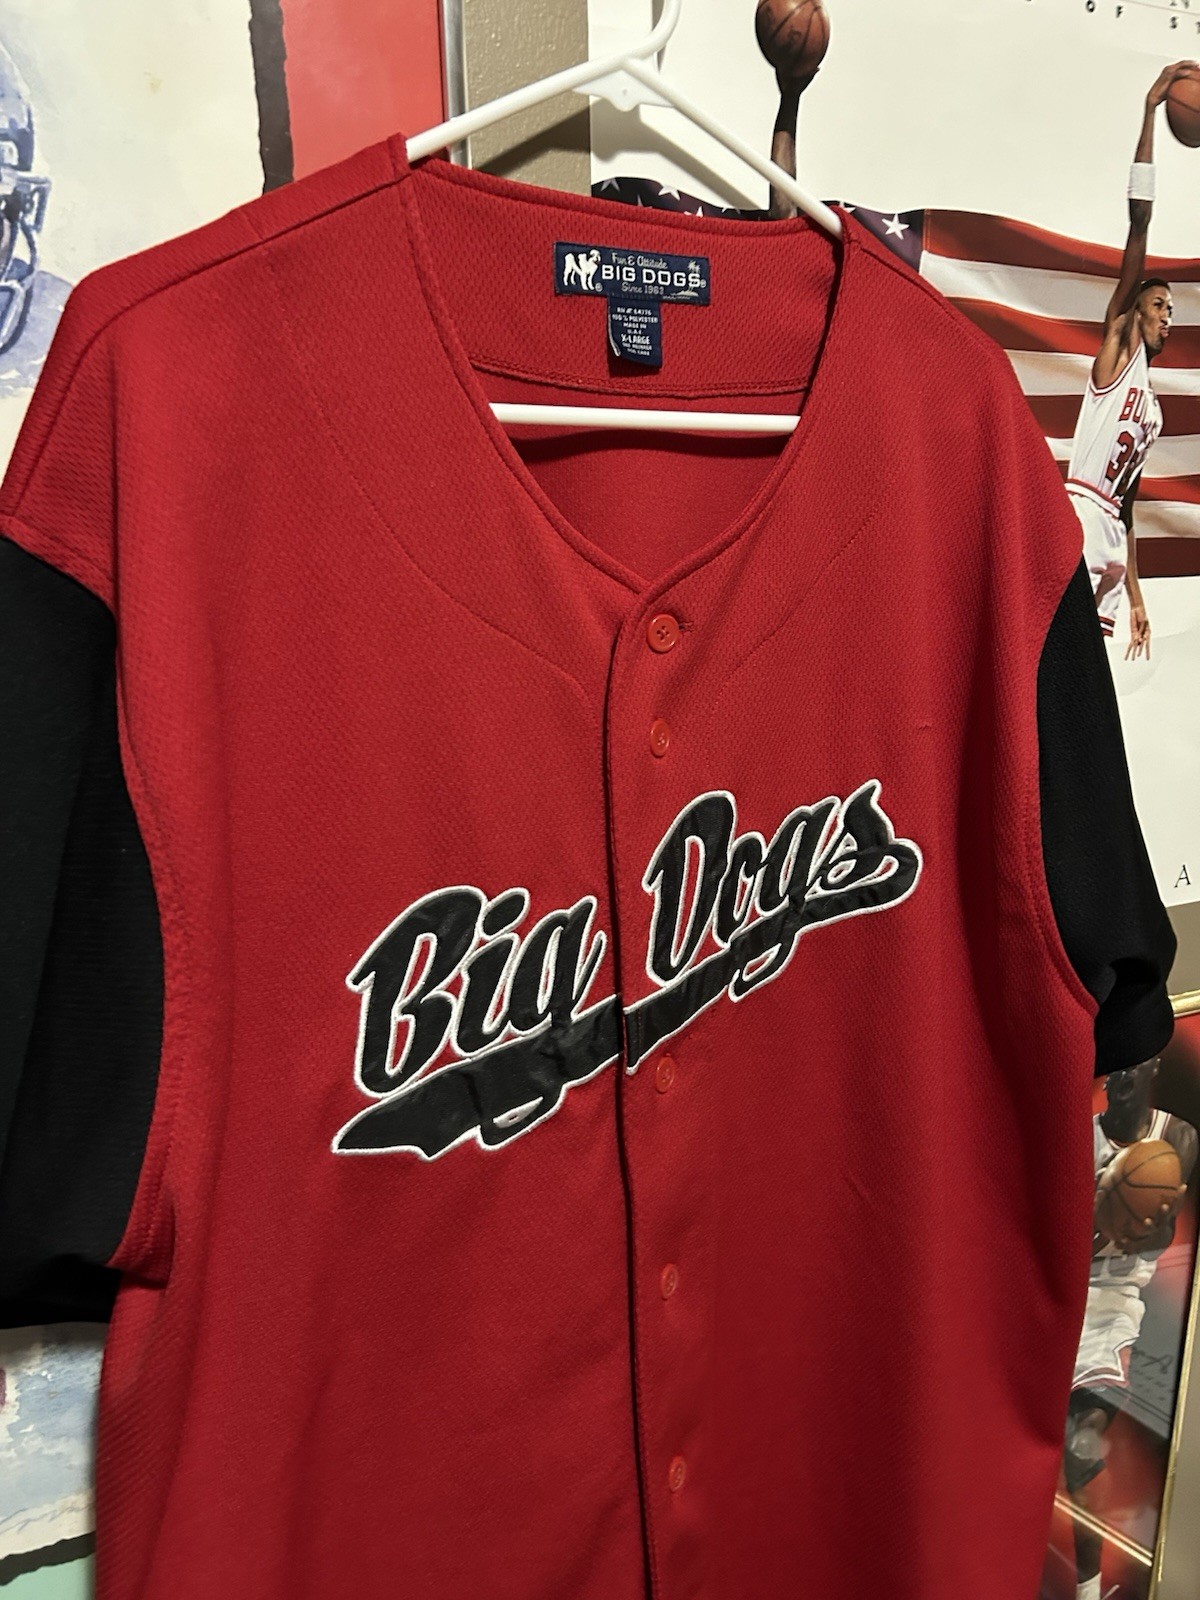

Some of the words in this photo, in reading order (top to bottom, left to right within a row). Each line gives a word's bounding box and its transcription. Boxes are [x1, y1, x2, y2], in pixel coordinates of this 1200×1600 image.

[611, 253, 628, 265] Fun
[637, 256, 668, 270] Attitude
[602, 265, 636, 282] BIG
[642, 268, 701, 288] DOGS
[621, 281, 643, 294] Since
[629, 315, 659, 324] POLYESTER
[621, 333, 650, 345] X-LARGE
[1174, 864, 1191, 888] A
[340, 884, 610, 1150] Big
[642, 778, 923, 1003] Dogs
